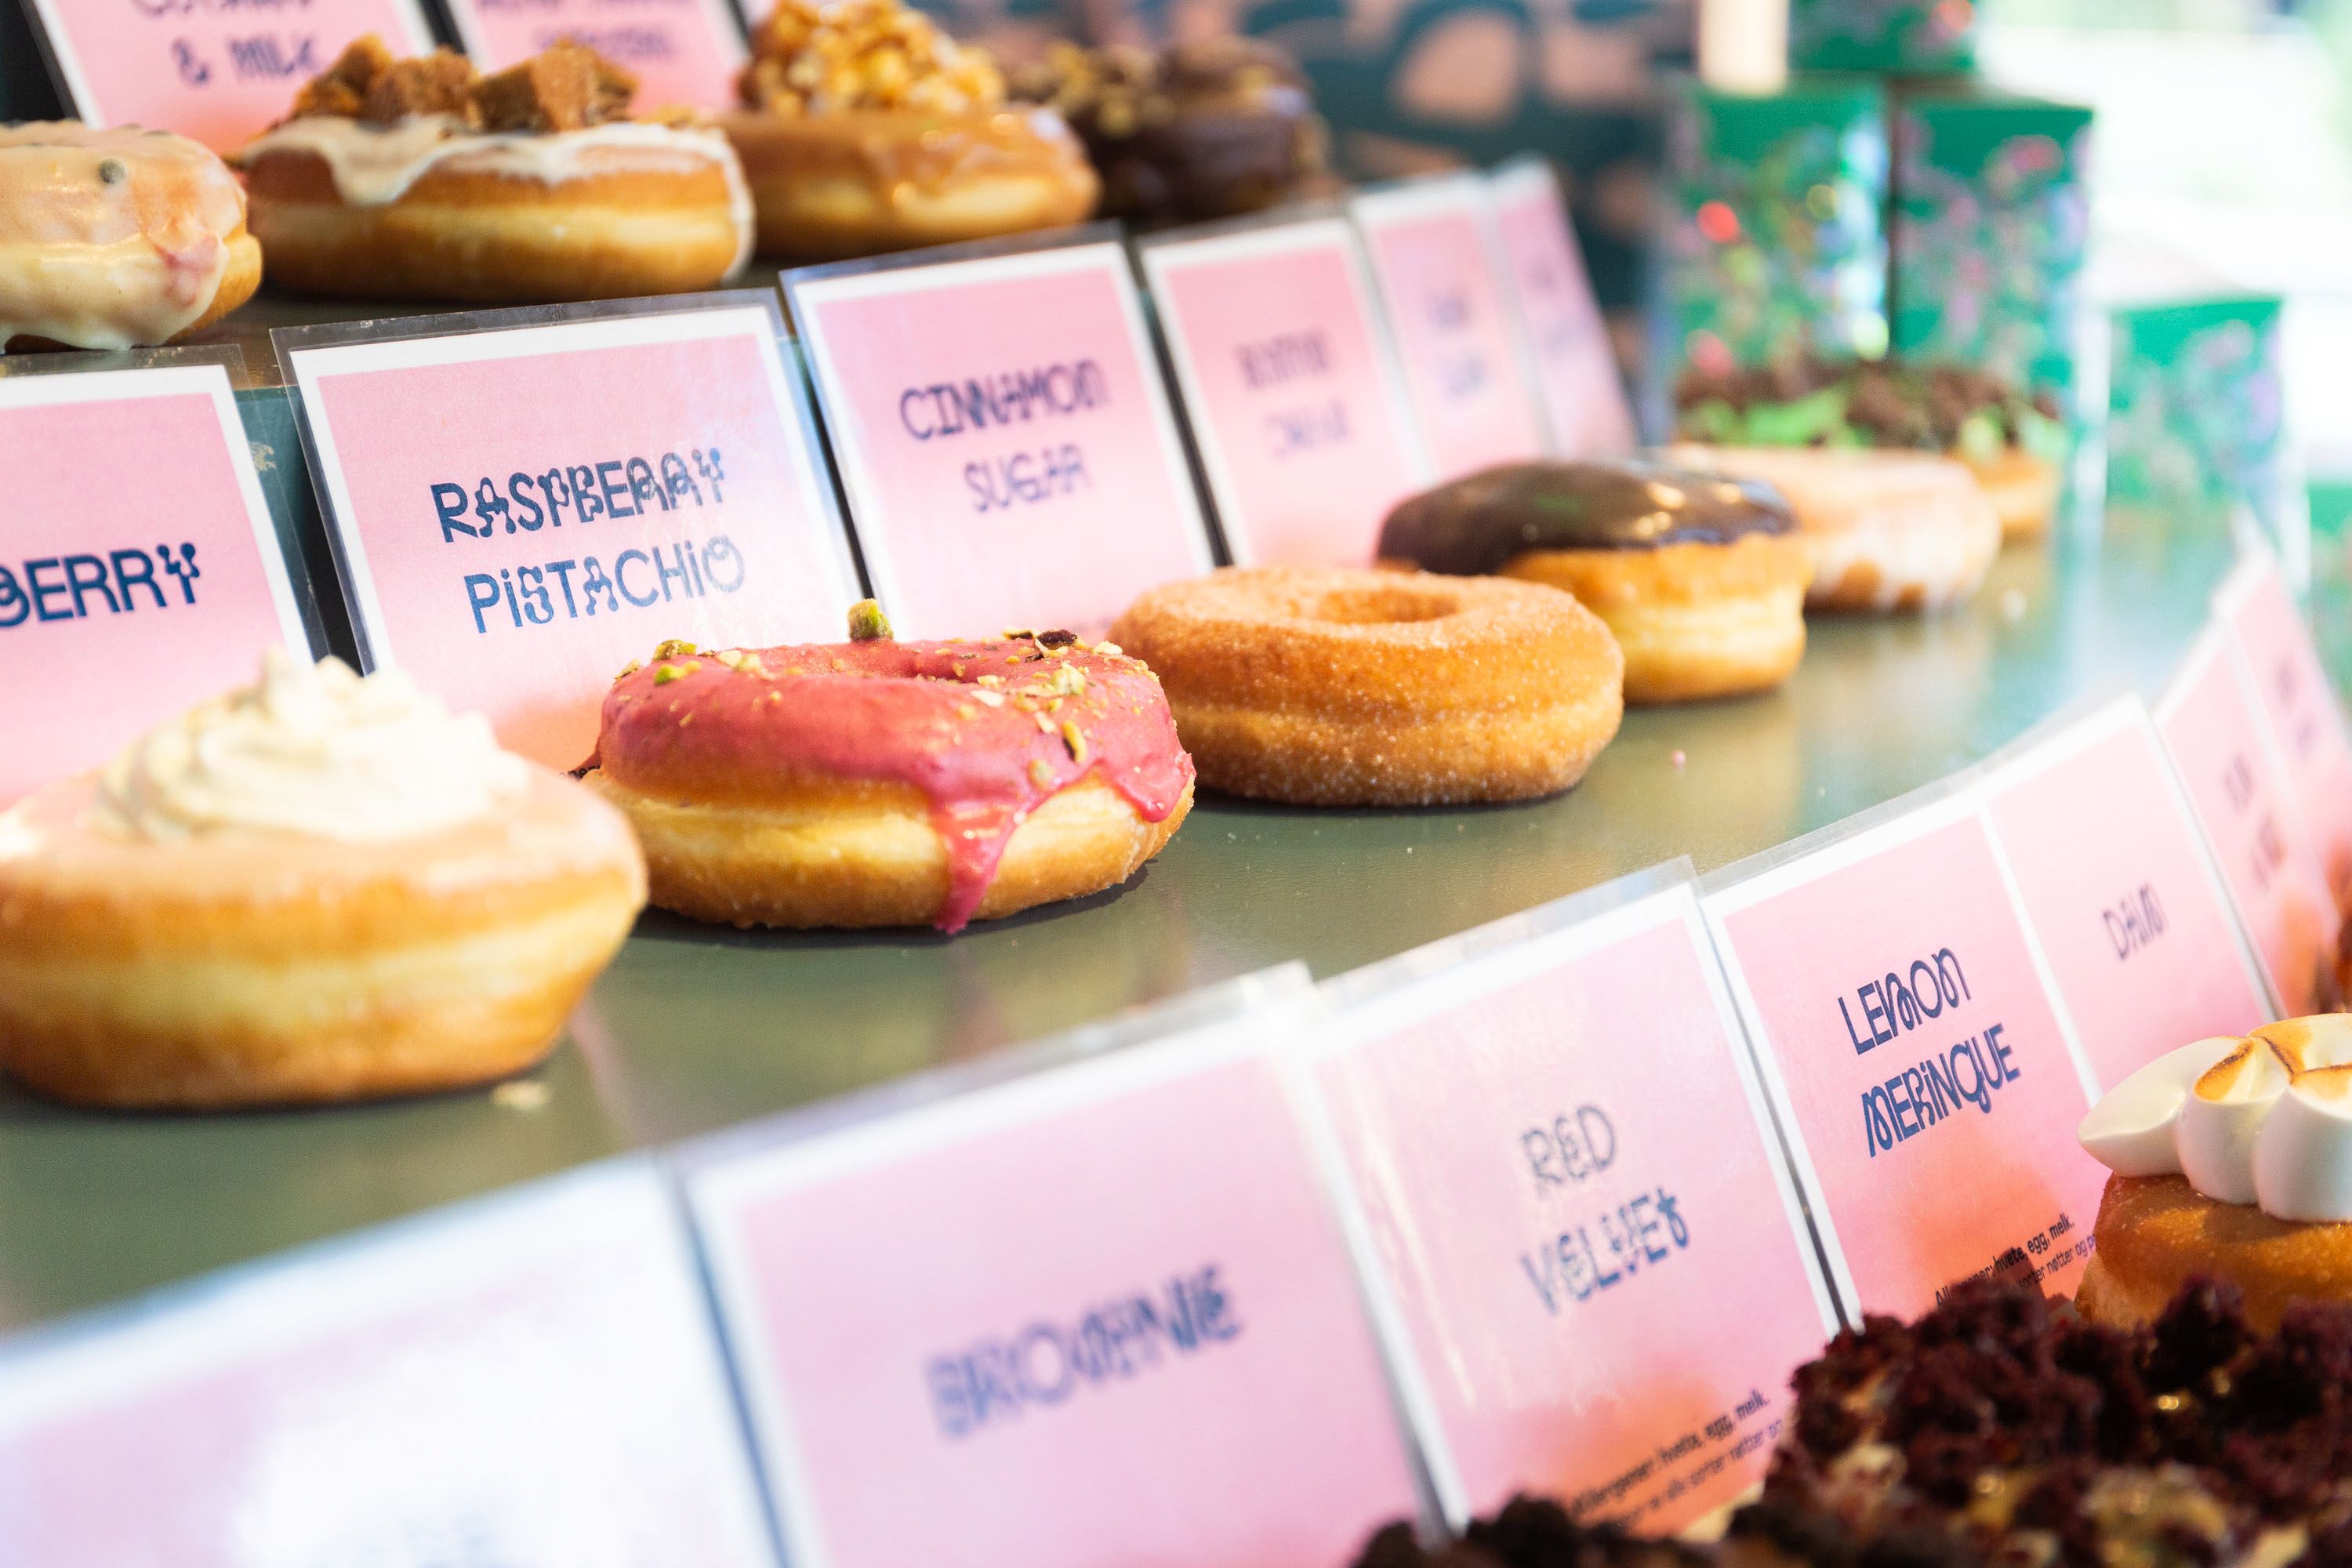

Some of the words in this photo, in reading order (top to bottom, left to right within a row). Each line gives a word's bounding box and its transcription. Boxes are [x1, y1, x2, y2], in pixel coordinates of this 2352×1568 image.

[899, 358, 1112, 441] CINNAMON
[430, 446, 724, 543] RASPBERRY
[963, 443, 1092, 513] SUGAR
[1838, 947, 1972, 1055] LEMON
[1520, 1105, 1614, 1197] RED
[1520, 1187, 1690, 1316] VELVET
[2027, 1232, 2051, 1255] egg,
[2049, 1212, 2075, 1240] melk.
[2074, 1240, 2089, 1258] og
